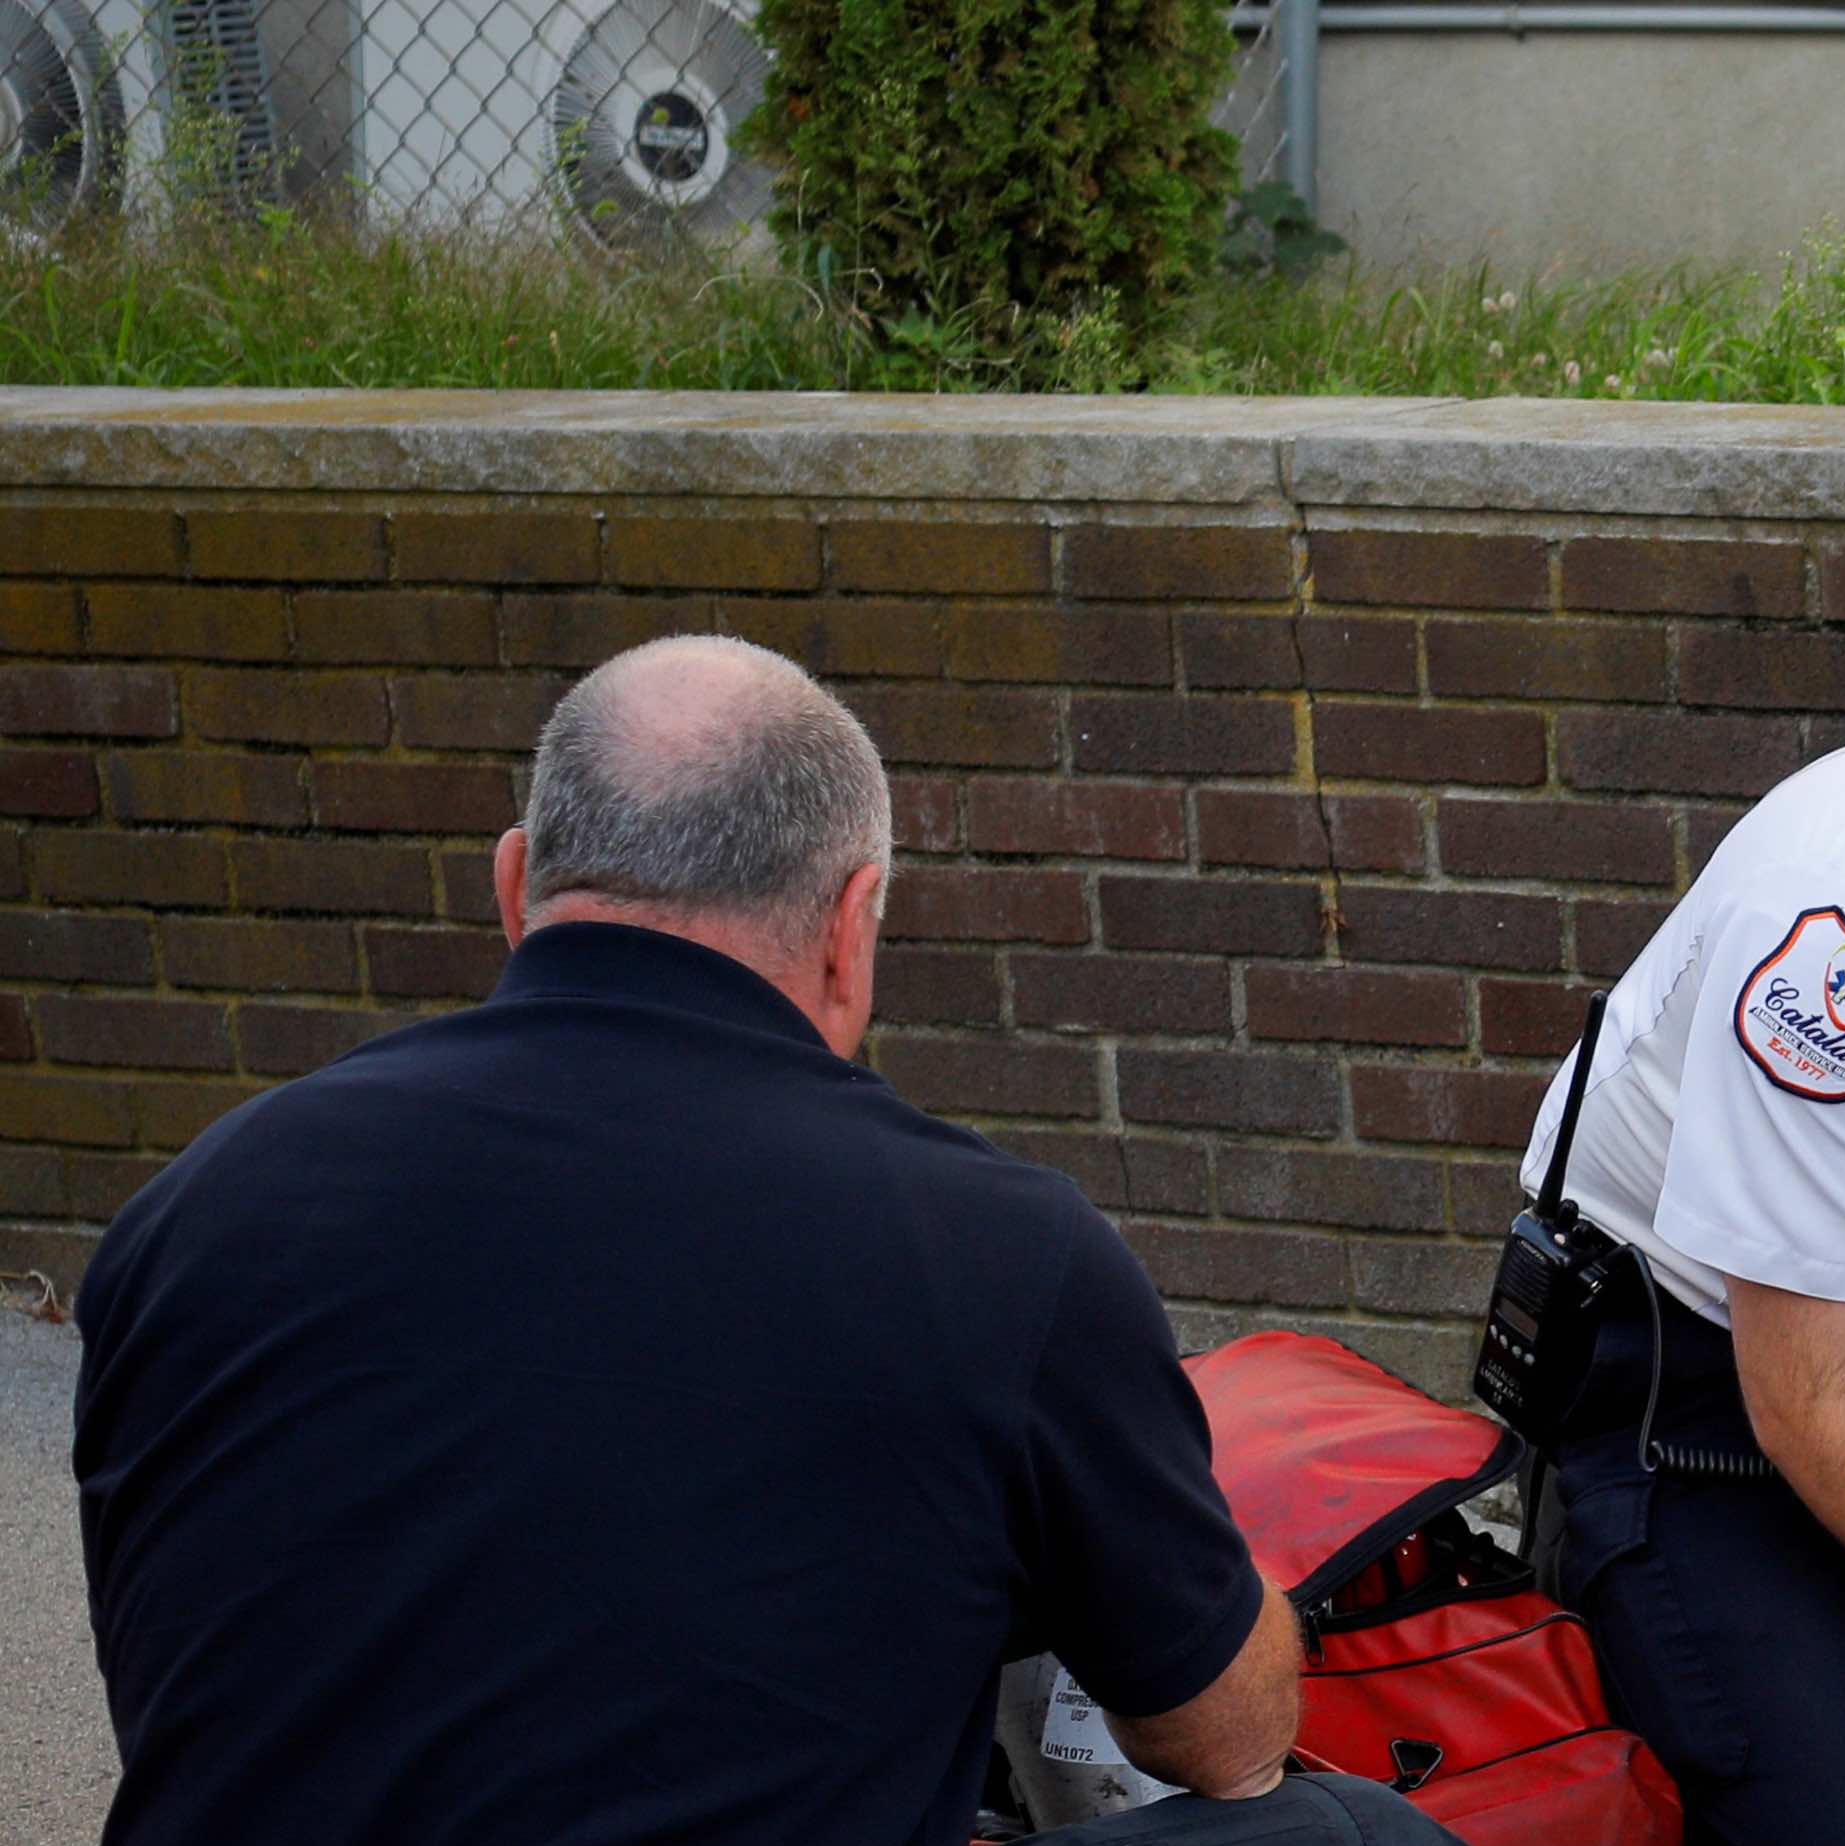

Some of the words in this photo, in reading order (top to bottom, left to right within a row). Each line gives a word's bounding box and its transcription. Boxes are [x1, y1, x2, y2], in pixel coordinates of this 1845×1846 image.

[1795, 1057, 1826, 1081] 1977
[1071, 1709, 1089, 1722] USP
[1046, 1743, 1094, 1762] UN1072
